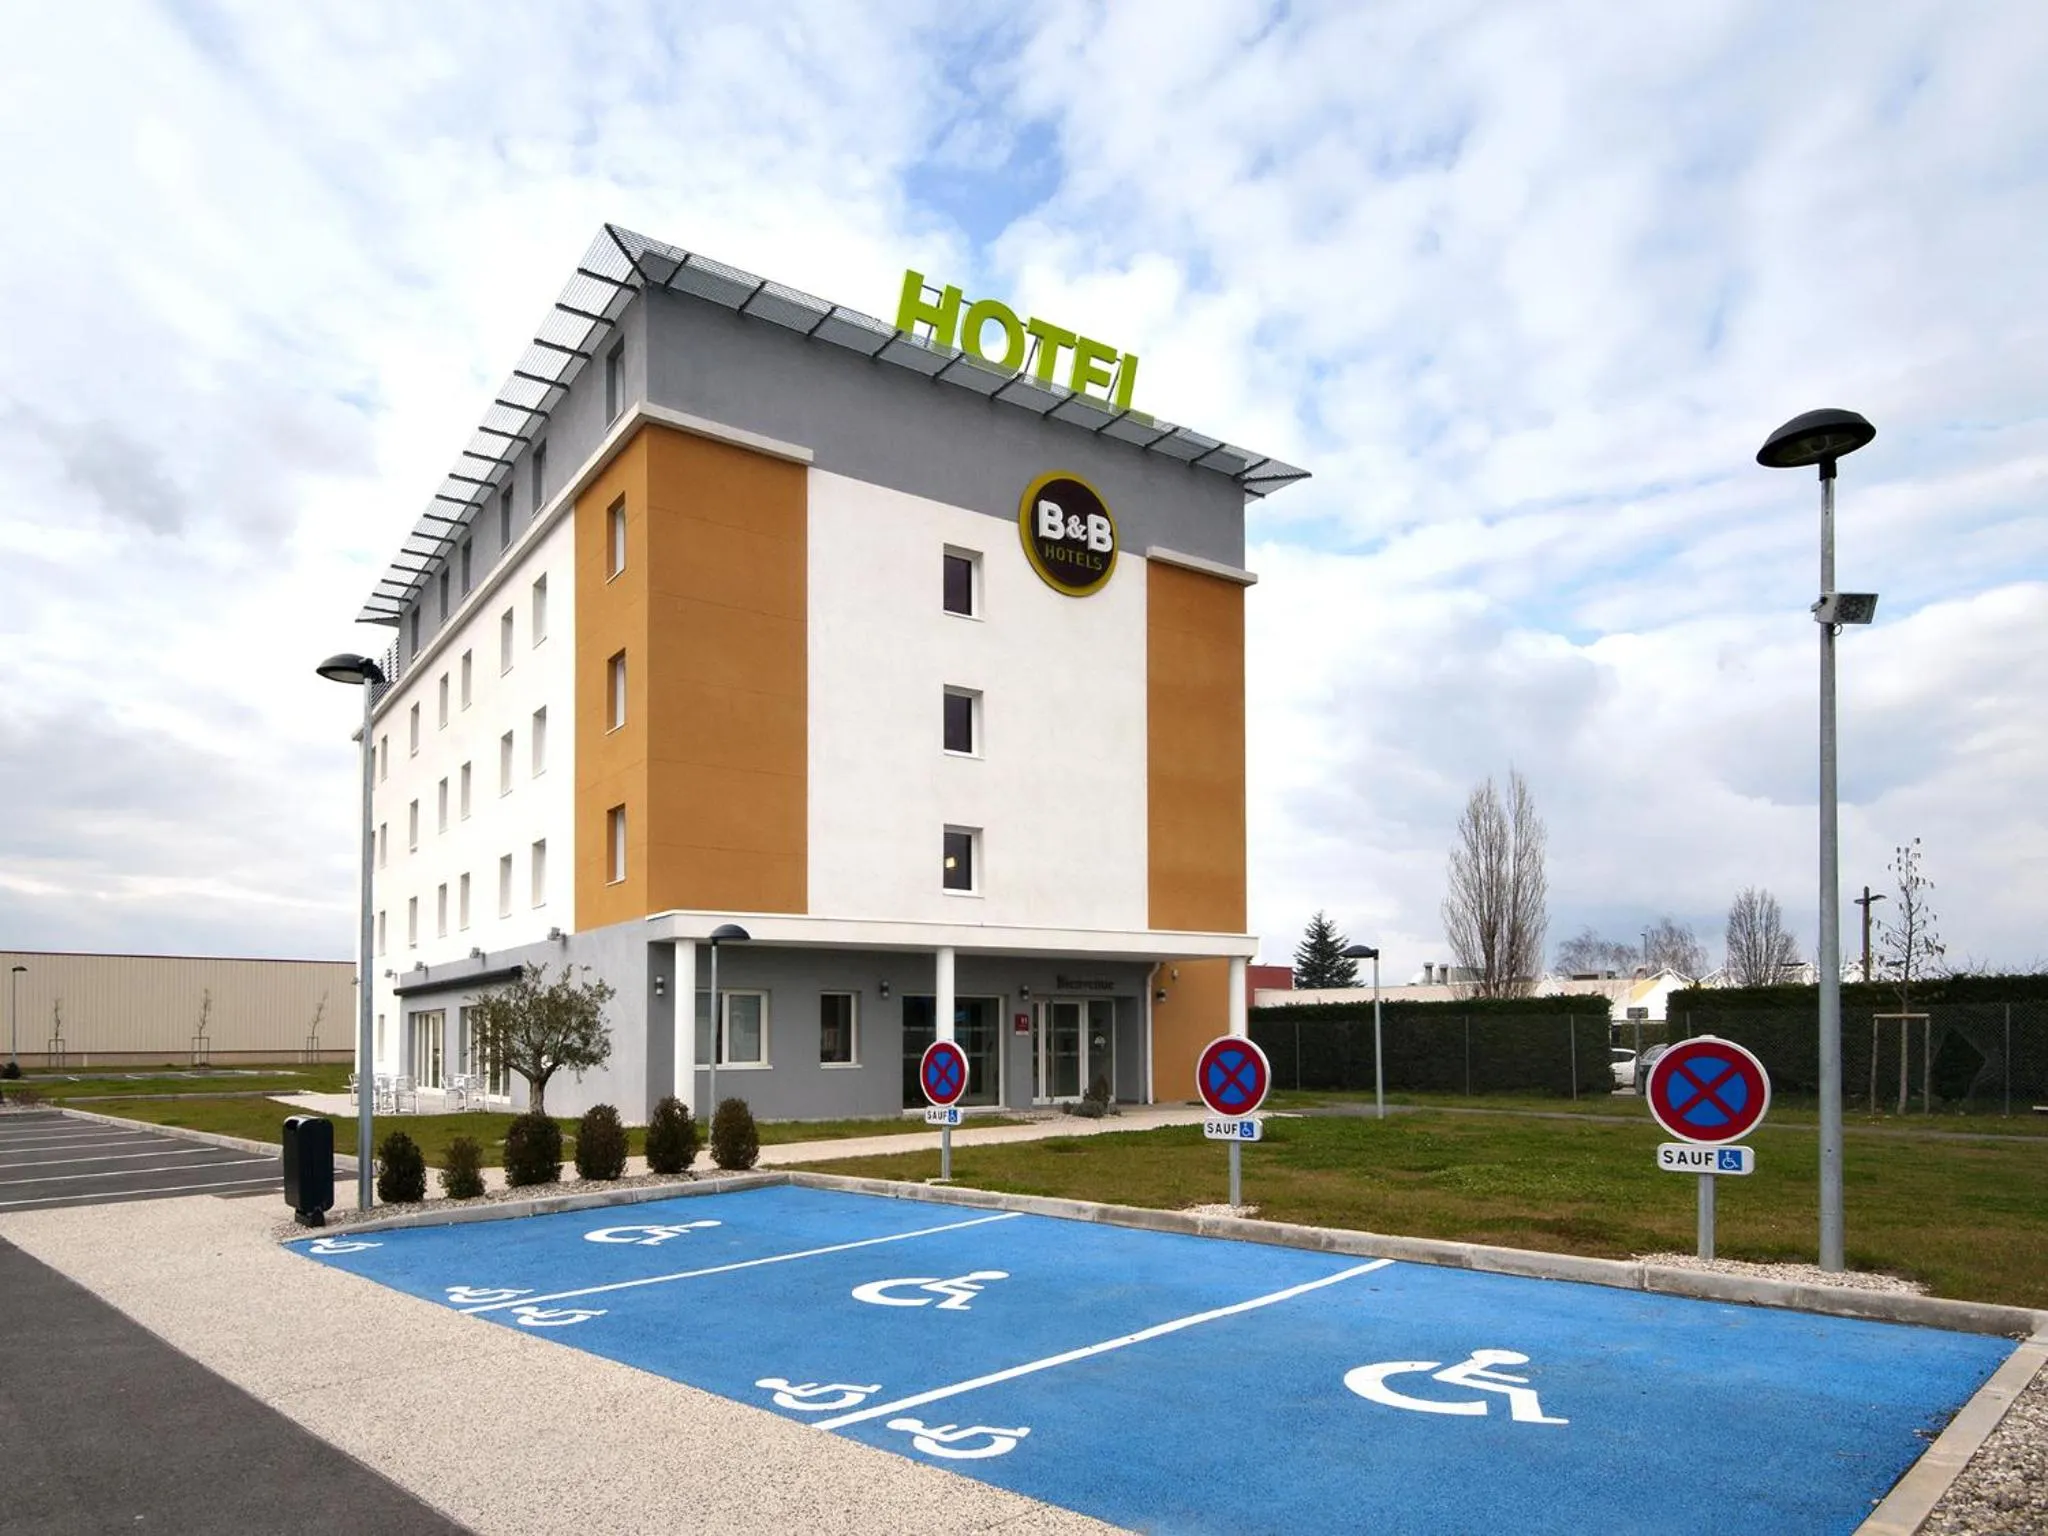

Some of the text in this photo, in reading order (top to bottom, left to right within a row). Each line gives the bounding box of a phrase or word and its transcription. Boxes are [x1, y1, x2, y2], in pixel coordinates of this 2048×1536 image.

[1038, 499, 1113, 553] B&B
[1045, 543, 1102, 570] HOTELS
[927, 1110, 948, 1121] SAUF
[1206, 1122, 1238, 1135] SAUF
[1663, 1150, 1715, 1166] SAUF
